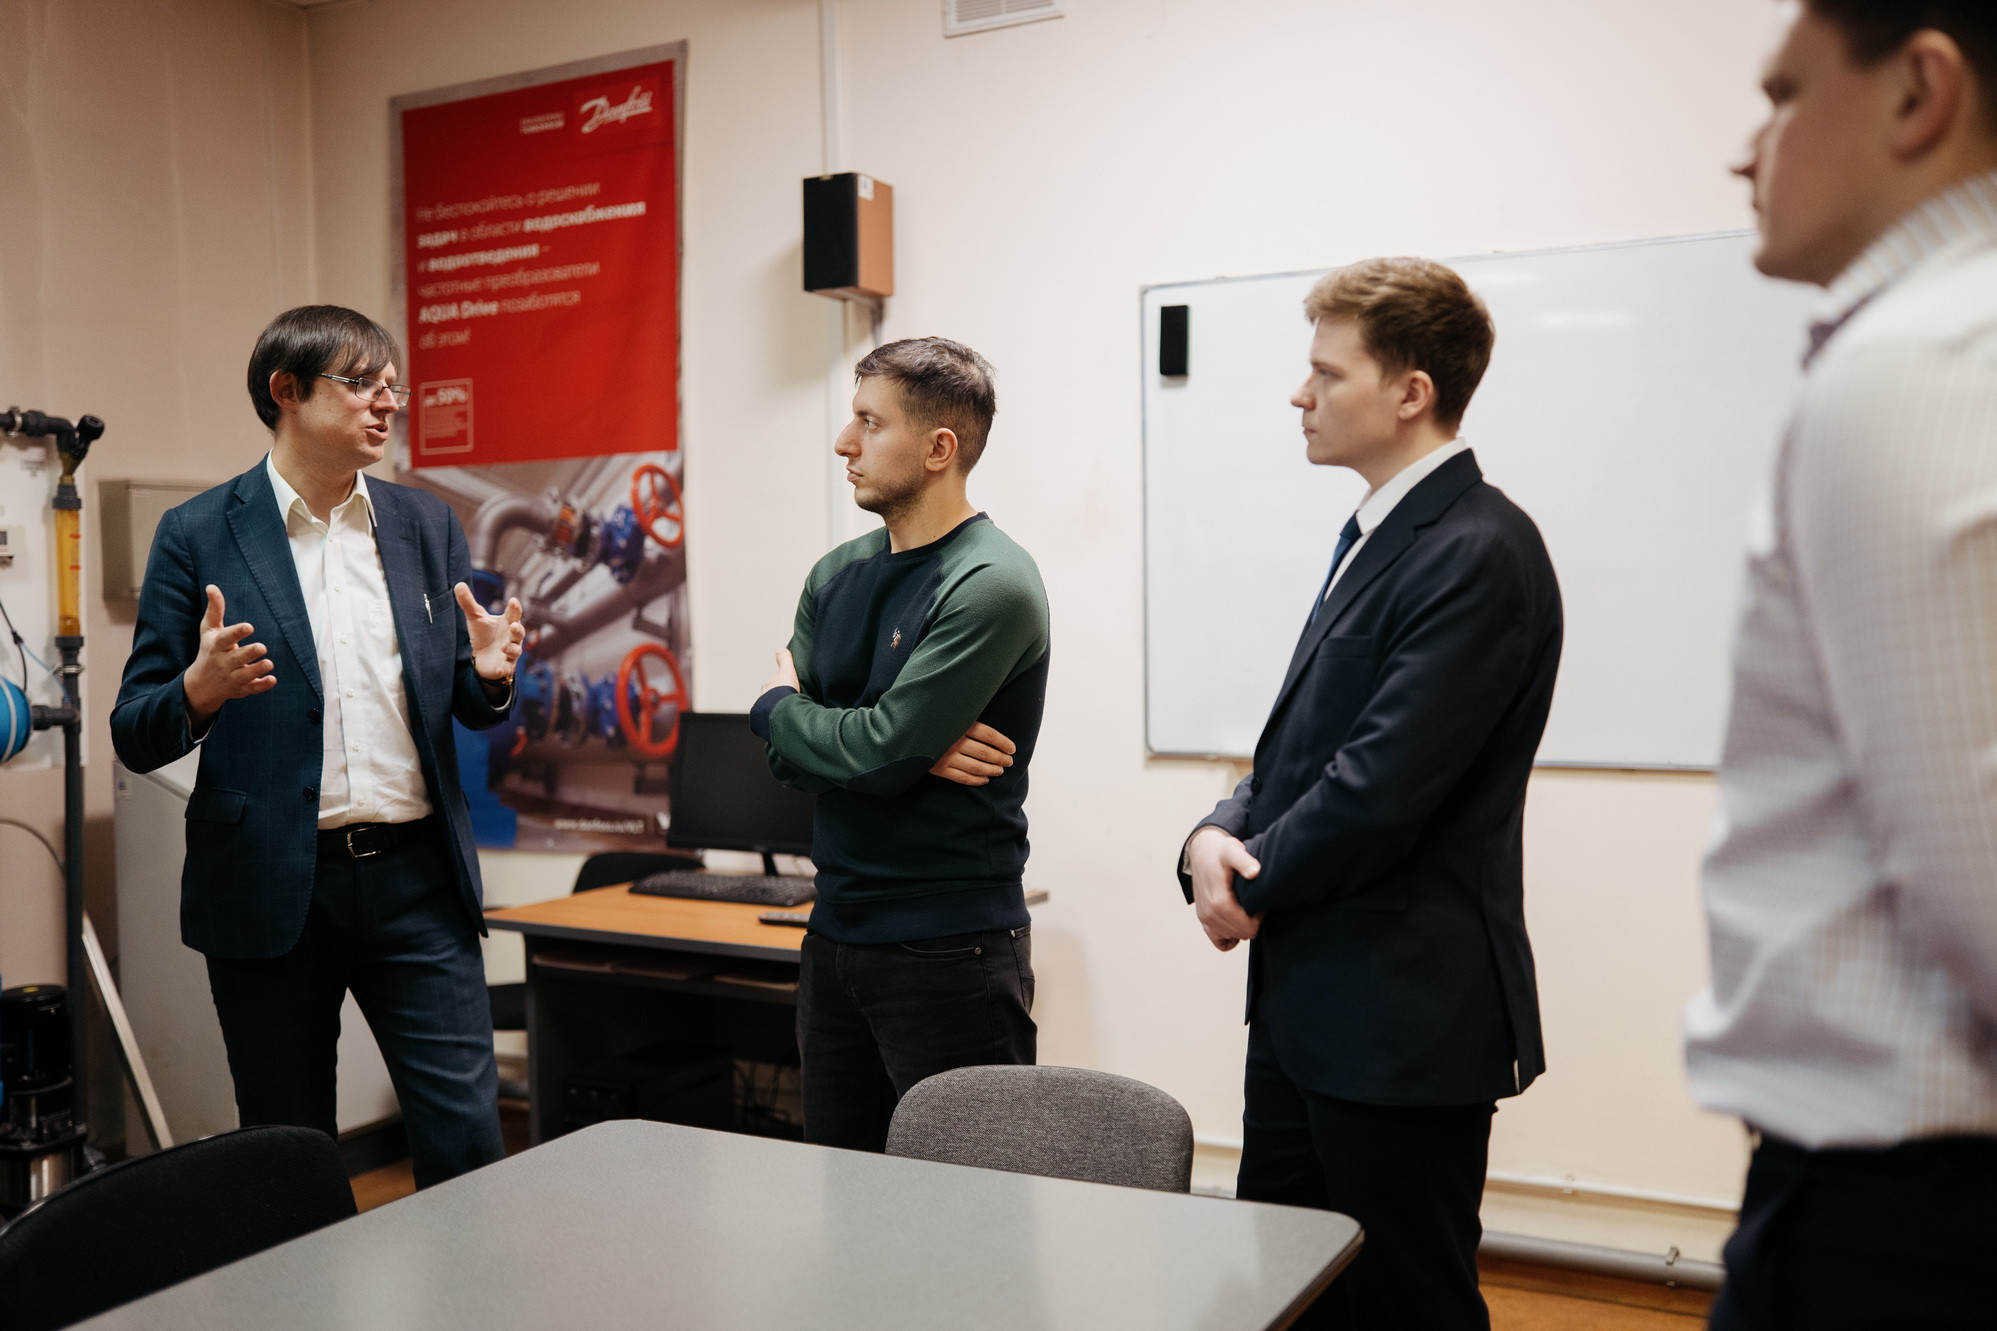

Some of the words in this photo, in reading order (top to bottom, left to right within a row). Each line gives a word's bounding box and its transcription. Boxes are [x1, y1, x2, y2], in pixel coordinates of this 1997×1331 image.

[524, 201, 646, 232] водоснабжения
[428, 243, 540, 272] водоотведения
[418, 302, 459, 324] AQUA
[460, 299, 499, 319] Drive
